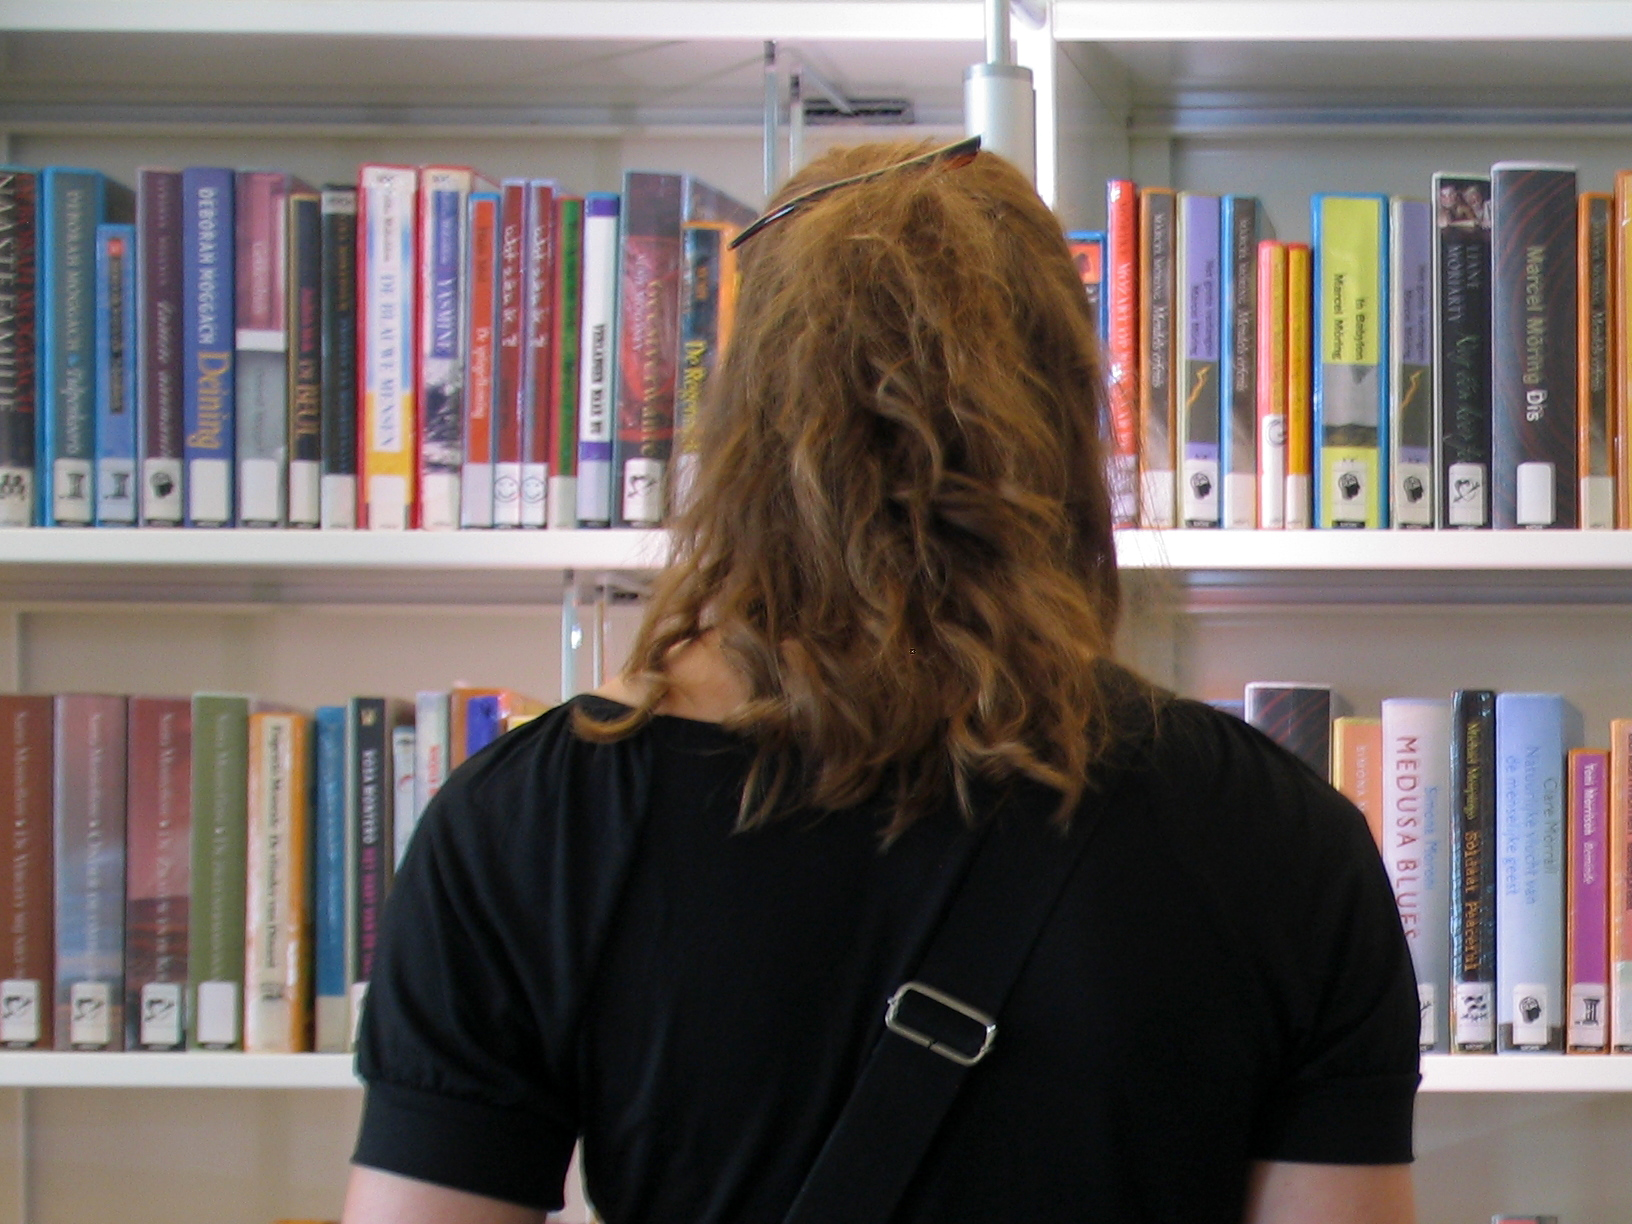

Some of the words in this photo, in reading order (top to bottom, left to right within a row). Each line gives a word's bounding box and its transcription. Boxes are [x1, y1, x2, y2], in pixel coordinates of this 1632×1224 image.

[198, 187, 219, 264] DEBORAH
[1334, 274, 1347, 315] Marcel
[1446, 245, 1464, 323] MORIARTY
[1465, 245, 1481, 290] LIANE
[1525, 247, 1548, 311] Marcel
[198, 268, 219, 345] MOGGACH
[1331, 320, 1348, 360] Möring
[1521, 317, 1551, 385] Möring
[189, 351, 232, 449] Deining
[1524, 389, 1549, 423] Dis
[1396, 736, 1419, 847] MEDUSA
[1583, 763, 1597, 785] Toni
[1583, 788, 1597, 835] Morrison
